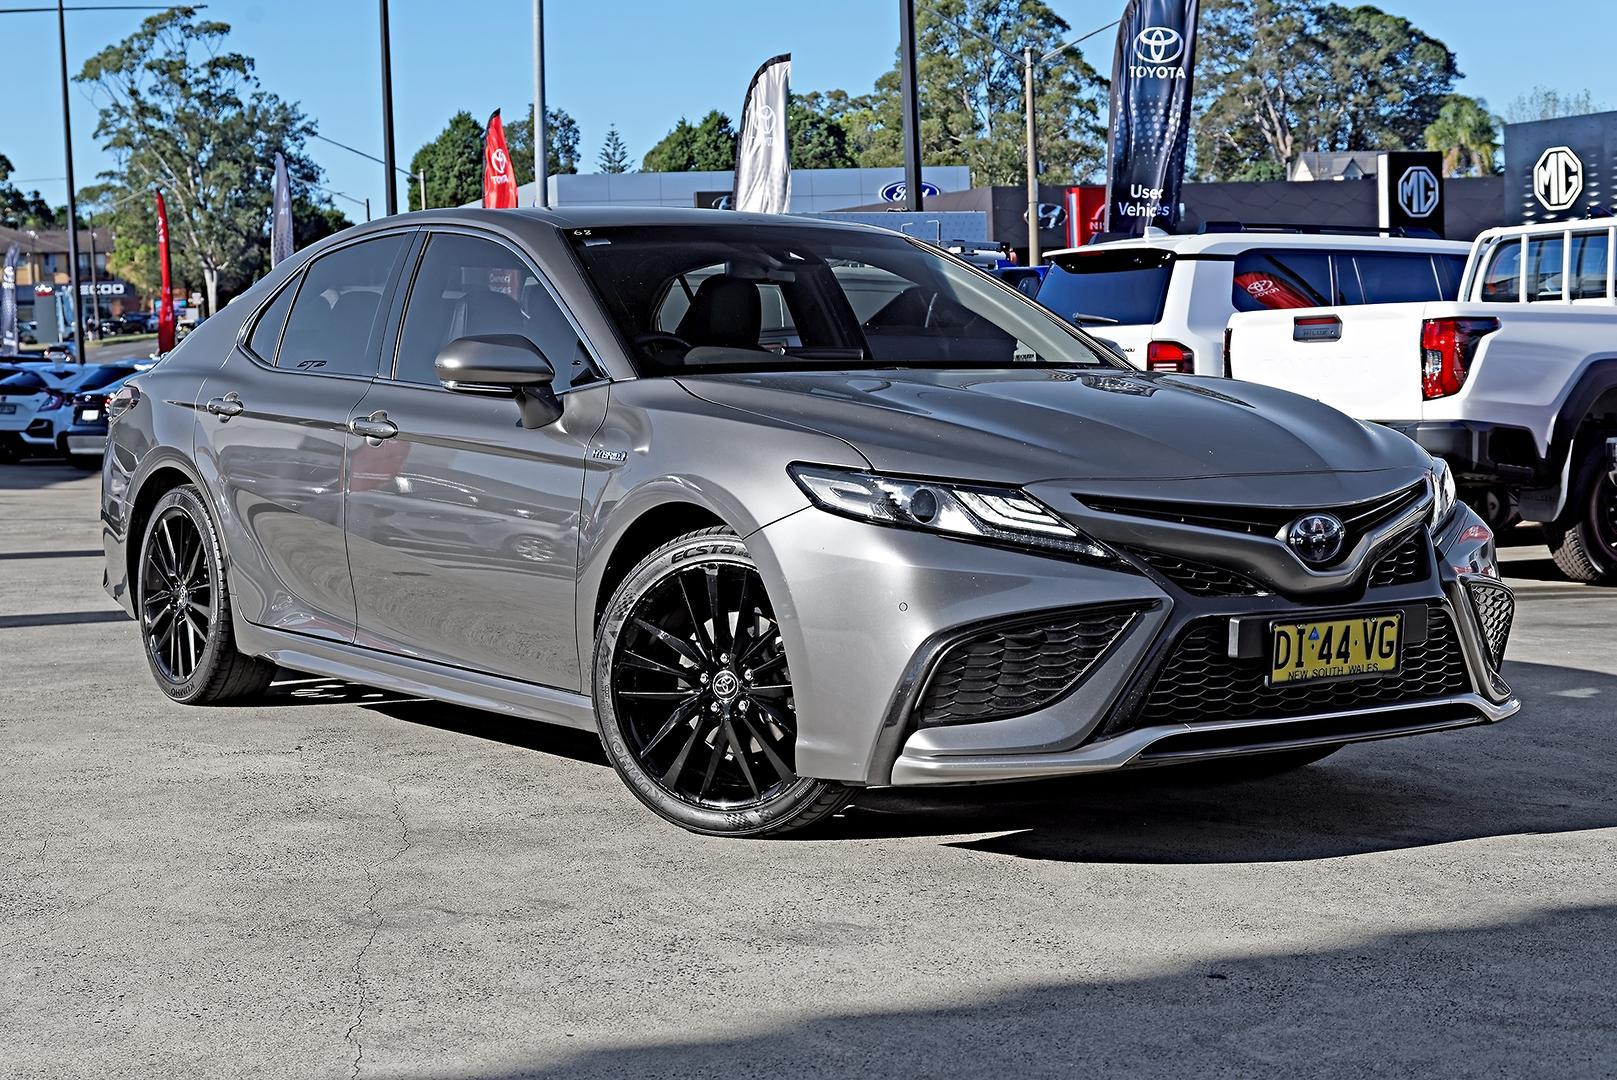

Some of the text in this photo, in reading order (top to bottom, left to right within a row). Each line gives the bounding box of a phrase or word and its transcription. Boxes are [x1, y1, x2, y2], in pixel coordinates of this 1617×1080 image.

[1129, 65, 1186, 79] TOYOTA
[1538, 151, 1579, 205] MG
[1402, 170, 1437, 213] MG
[1118, 201, 1170, 217] Vehices
[1288, 663, 1379, 681] NEW SOUTH WALES
[170, 681, 196, 697] KUMHO
[611, 739, 664, 806] KUMHO
